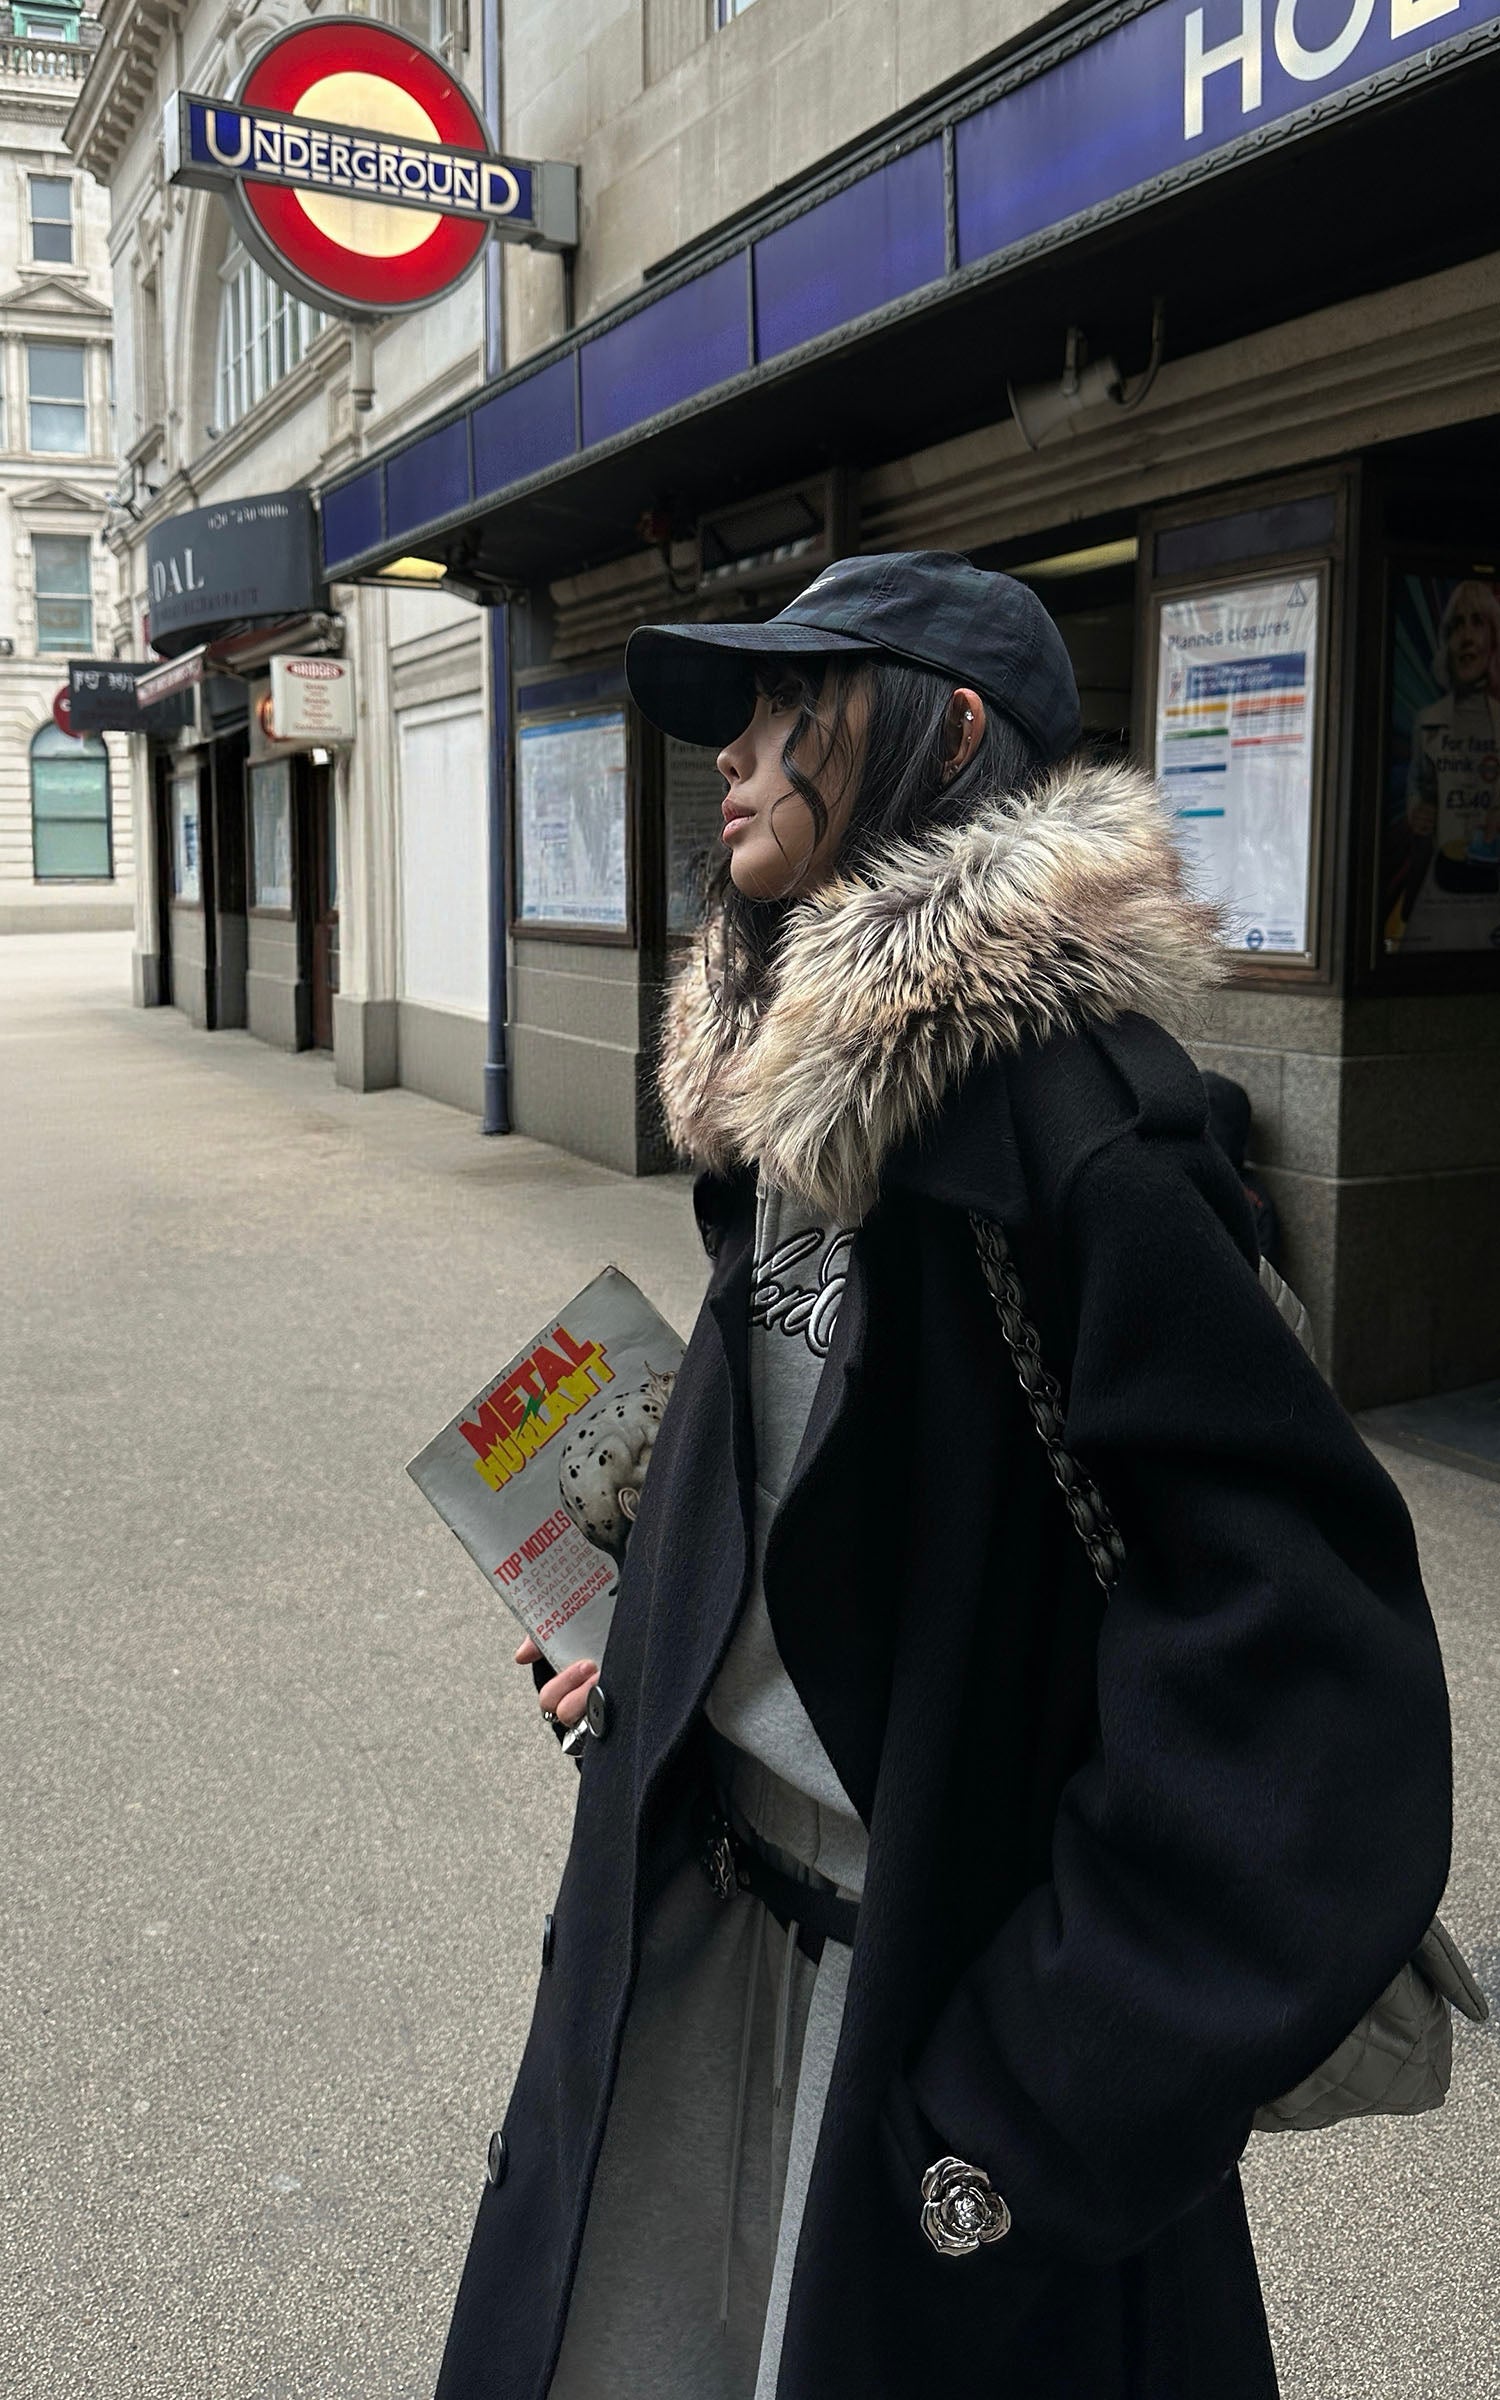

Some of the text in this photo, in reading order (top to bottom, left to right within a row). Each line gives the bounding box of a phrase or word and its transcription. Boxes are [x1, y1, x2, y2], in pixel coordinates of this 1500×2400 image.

[205, 108, 520, 216] UNDERGROUND
[1167, 619, 1290, 652] Planned closures
[1437, 756, 1473, 773] think
[1441, 735, 1463, 751] For
[458, 1325, 597, 1462] METAL
[473, 1341, 617, 1493] HURLANT
[493, 1508, 572, 1587] TOP MODELS
[508, 1528, 580, 1598] MACHINES
[536, 1563, 609, 1636] PAR DIONNET
[541, 1626, 556, 1642] ET
